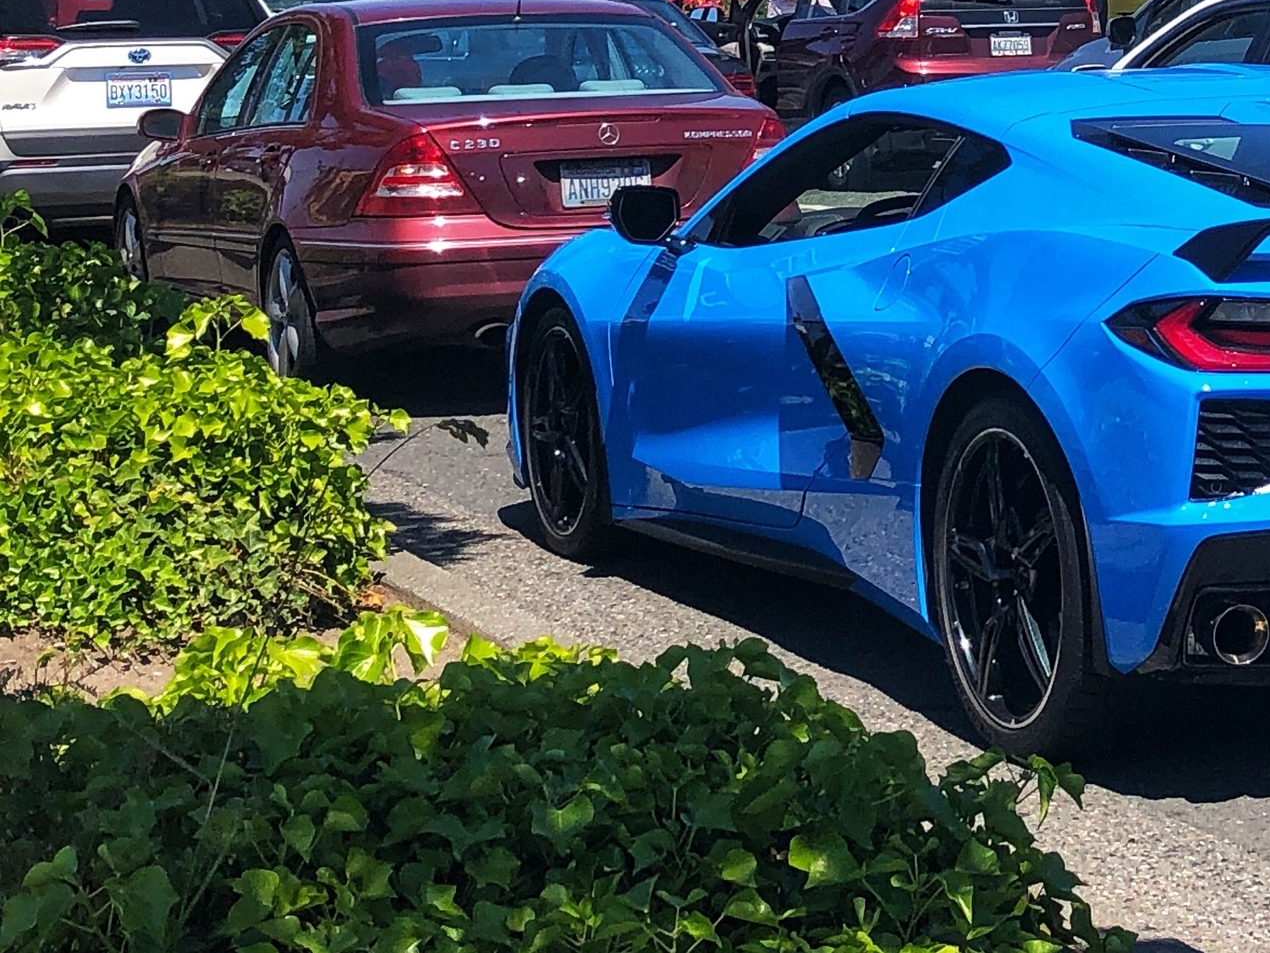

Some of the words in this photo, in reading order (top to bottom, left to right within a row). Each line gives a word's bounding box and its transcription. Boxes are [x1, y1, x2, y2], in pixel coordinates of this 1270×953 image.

[110, 83, 167, 100] BXY3150
[450, 139, 461, 150] C
[464, 138, 500, 150] 230
